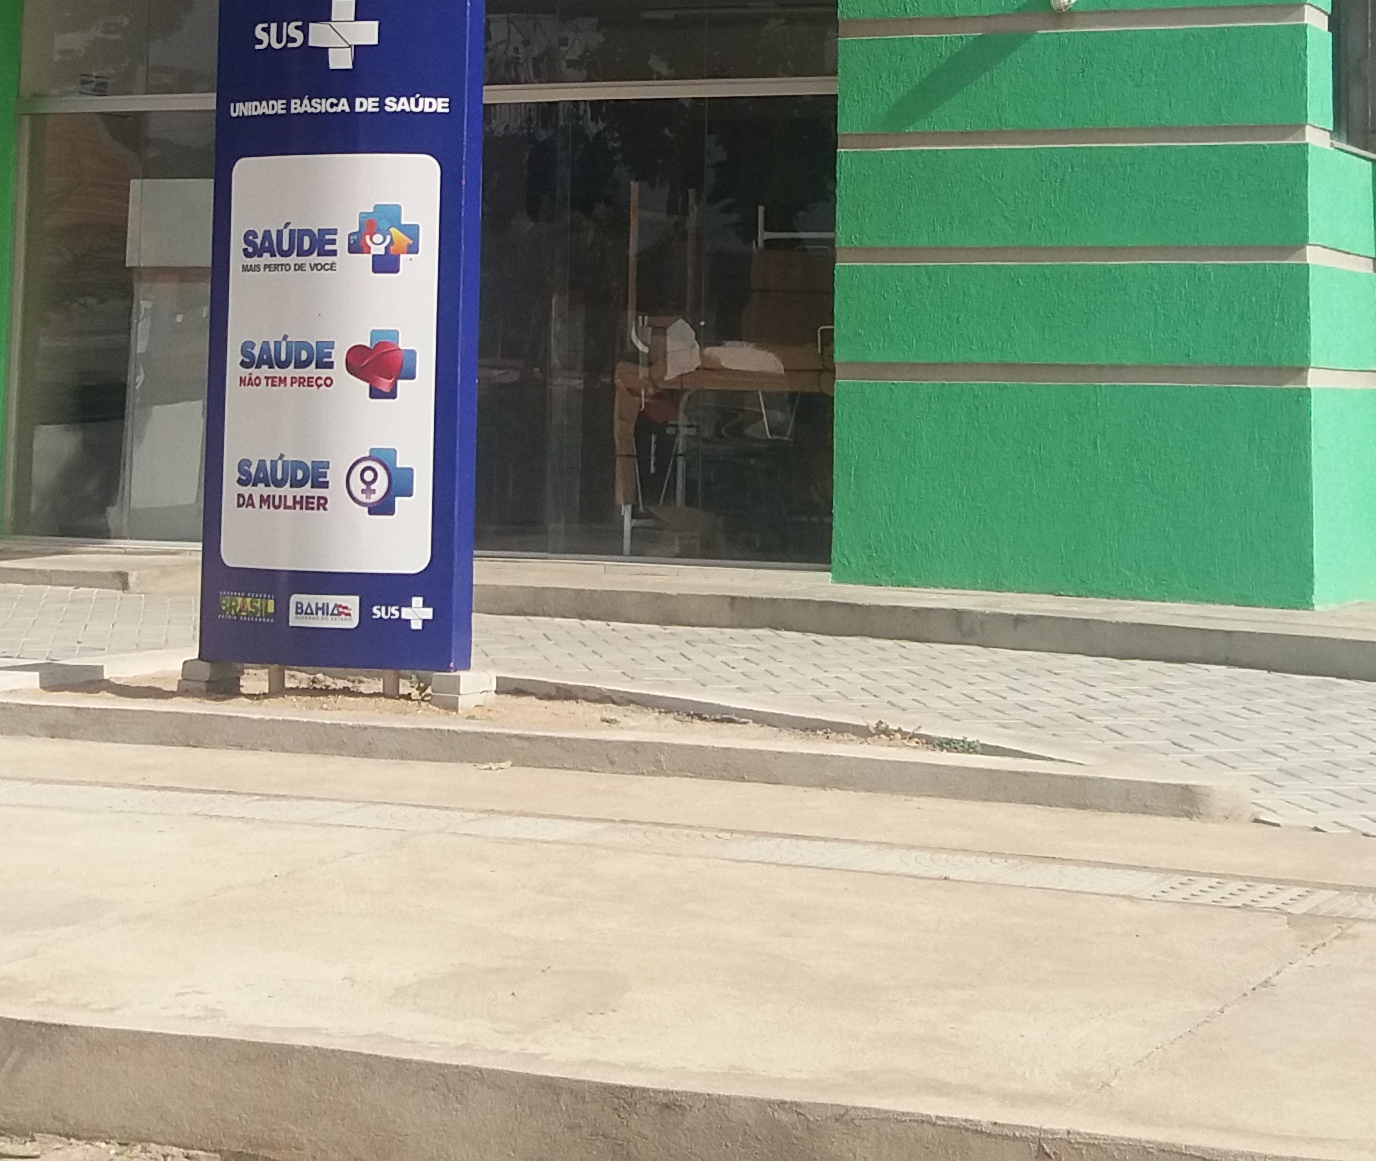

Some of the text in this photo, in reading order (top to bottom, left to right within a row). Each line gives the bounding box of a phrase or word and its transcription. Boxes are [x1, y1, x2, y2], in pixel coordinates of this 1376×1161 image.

[254, 21, 305, 50] SUS
[230, 94, 450, 118] UNIDADE BÁSICA DE SAÚDE
[242, 221, 338, 258] SAÚDE
[241, 261, 337, 272] MAIS PERTO DE VOCÊ
[239, 333, 335, 369] SAÚDE
[239, 373, 334, 389] NÃO TEM PREÇO
[236, 453, 330, 489] SAÚDE
[236, 493, 329, 511] DA MULHER
[220, 596, 275, 617] BRASIL
[295, 601, 341, 616] BAHIA
[372, 604, 401, 619] SUS
